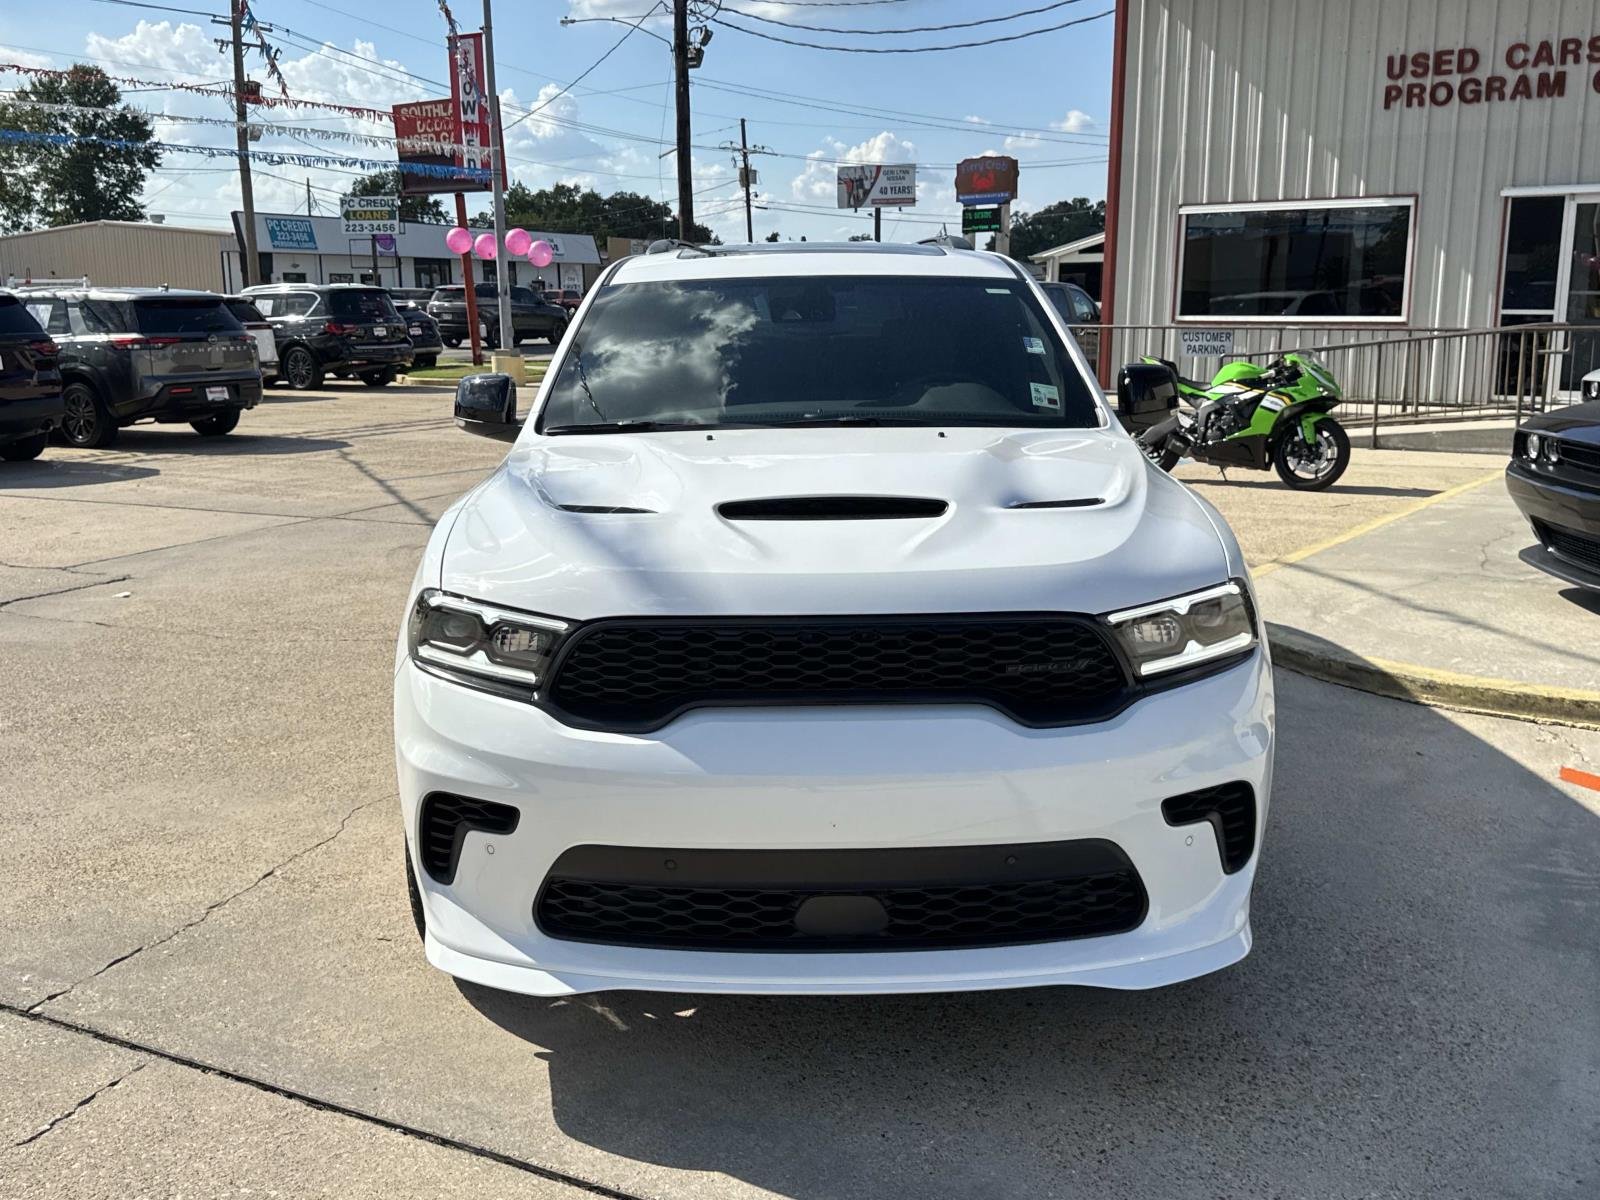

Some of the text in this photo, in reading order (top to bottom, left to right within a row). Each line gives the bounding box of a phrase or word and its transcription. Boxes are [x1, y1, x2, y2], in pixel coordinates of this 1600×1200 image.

[1387, 36, 1600, 80] USED CARS
[1384, 71, 1566, 110] PROGRAM
[879, 186, 888, 195] 40
[340, 198, 397, 208] PC CREDIT
[350, 211, 389, 220] LOANS
[266, 219, 311, 232] PC CREDIT
[1182, 331, 1232, 343] CUSTOMER
[1186, 344, 1226, 355] PARKING
